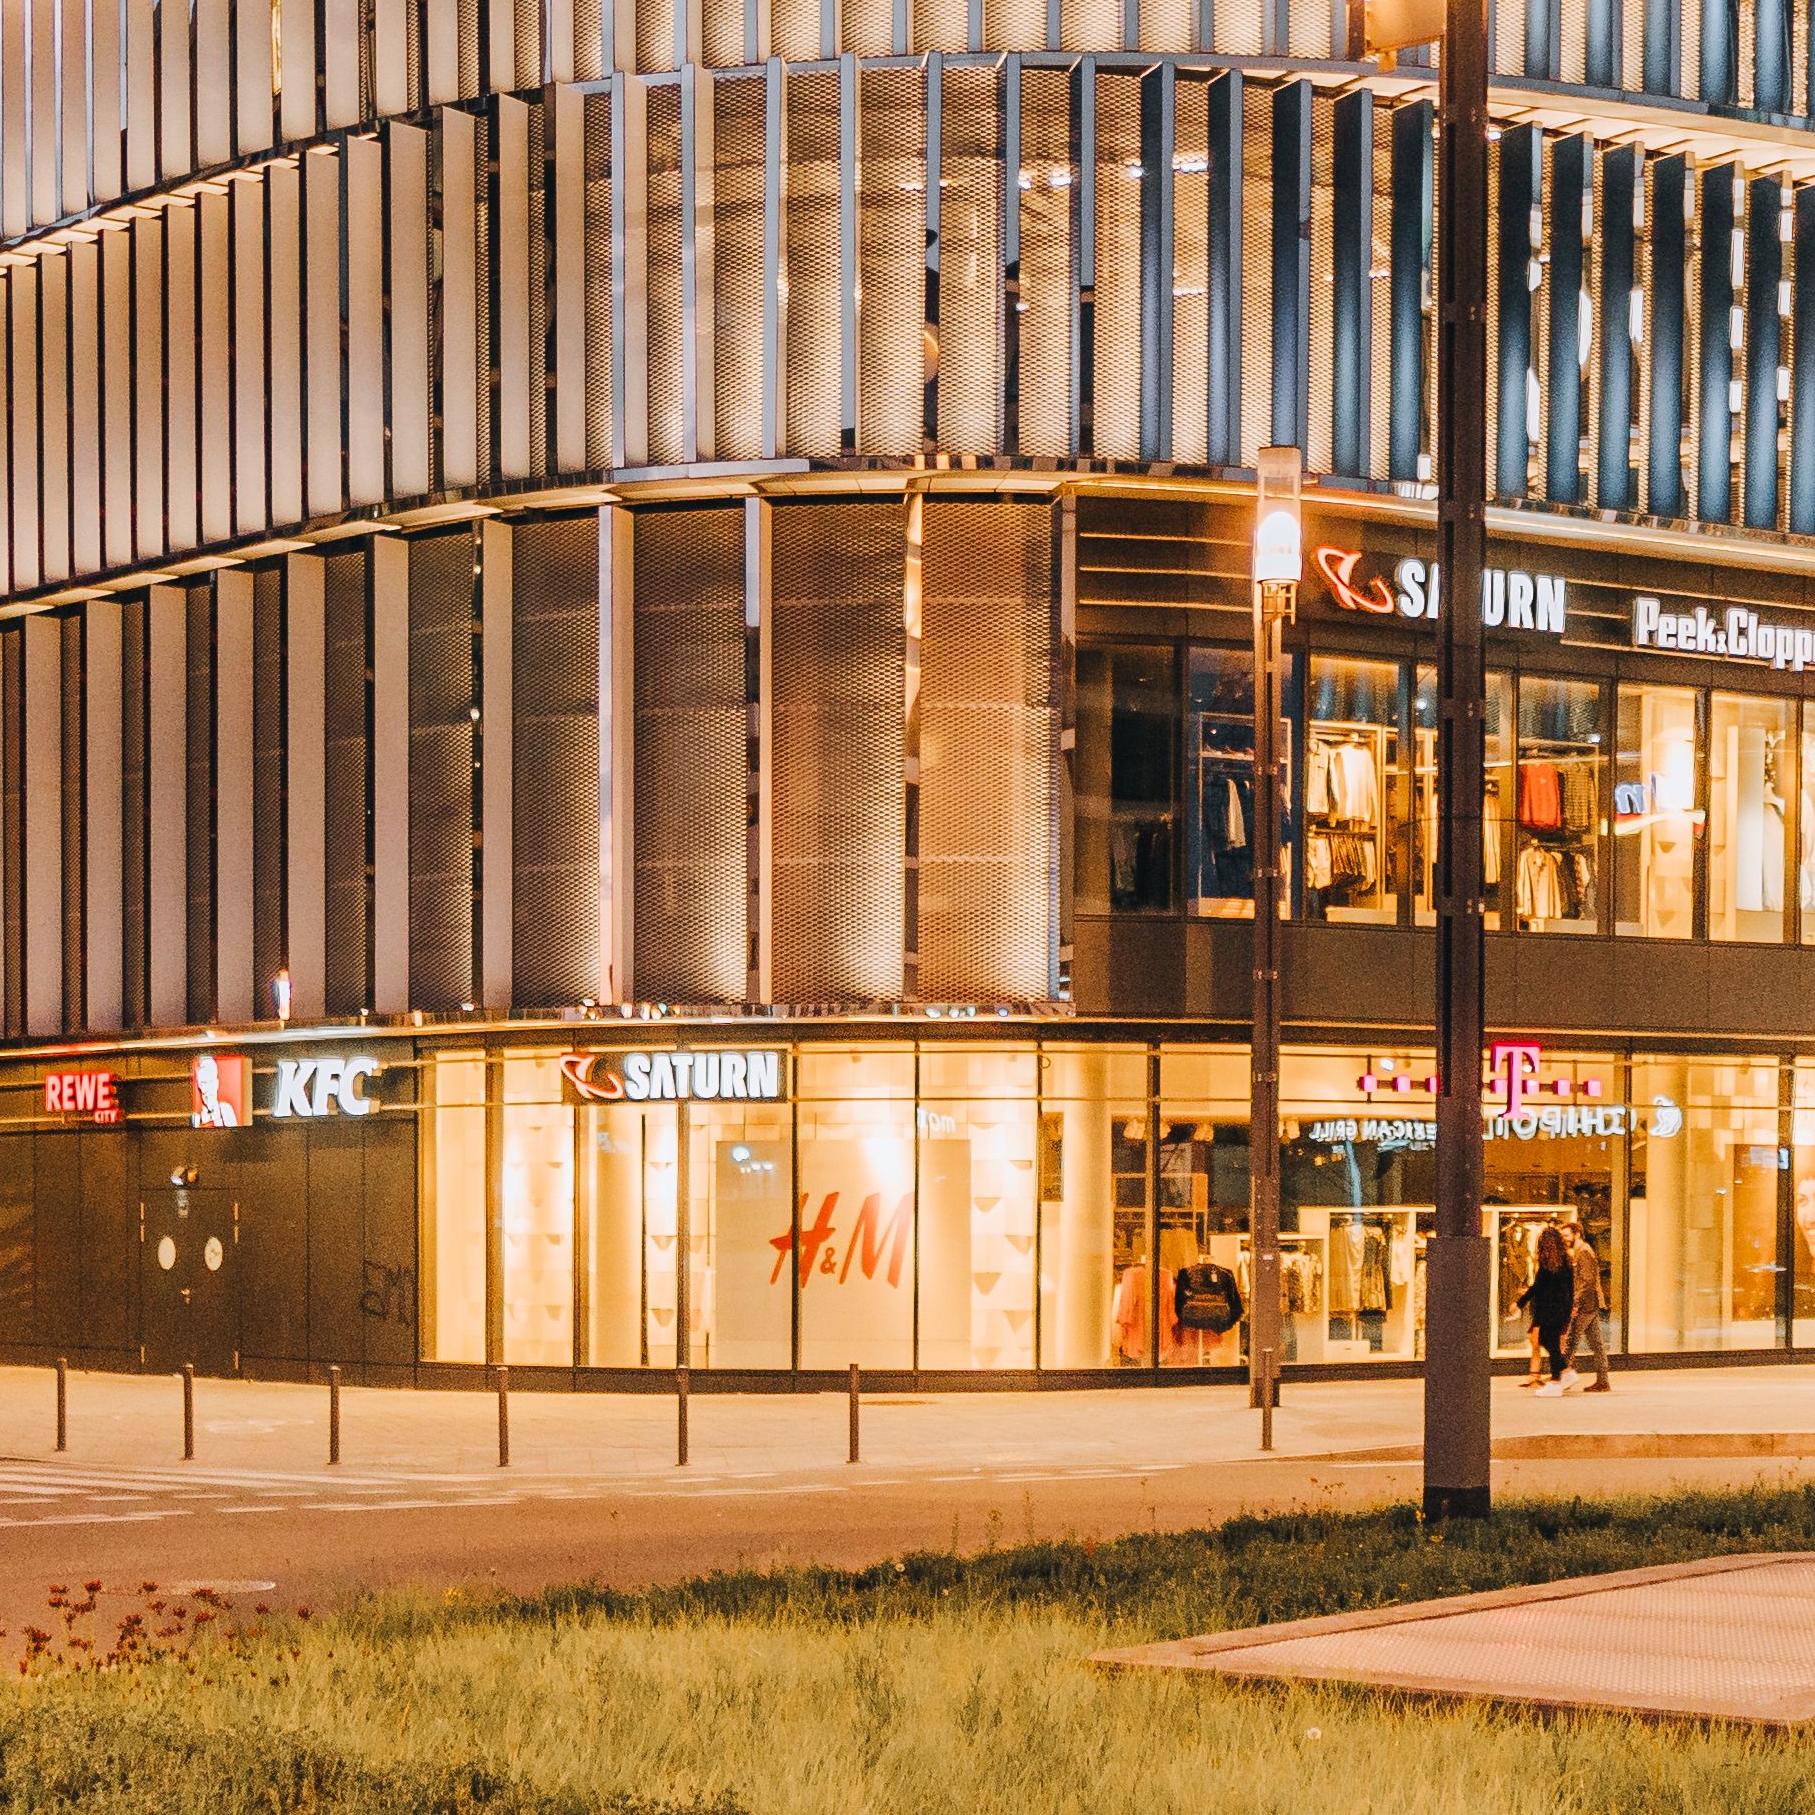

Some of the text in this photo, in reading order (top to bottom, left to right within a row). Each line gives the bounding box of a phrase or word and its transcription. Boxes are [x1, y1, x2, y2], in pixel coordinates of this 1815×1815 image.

[1397, 558, 1565, 633] SURN
[46, 1073, 114, 1112] REWE
[272, 1057, 381, 1118] KFC
[623, 1052, 780, 1100] SATURN
[94, 1109, 119, 1124] CITY
[768, 1191, 916, 1290] H&M
